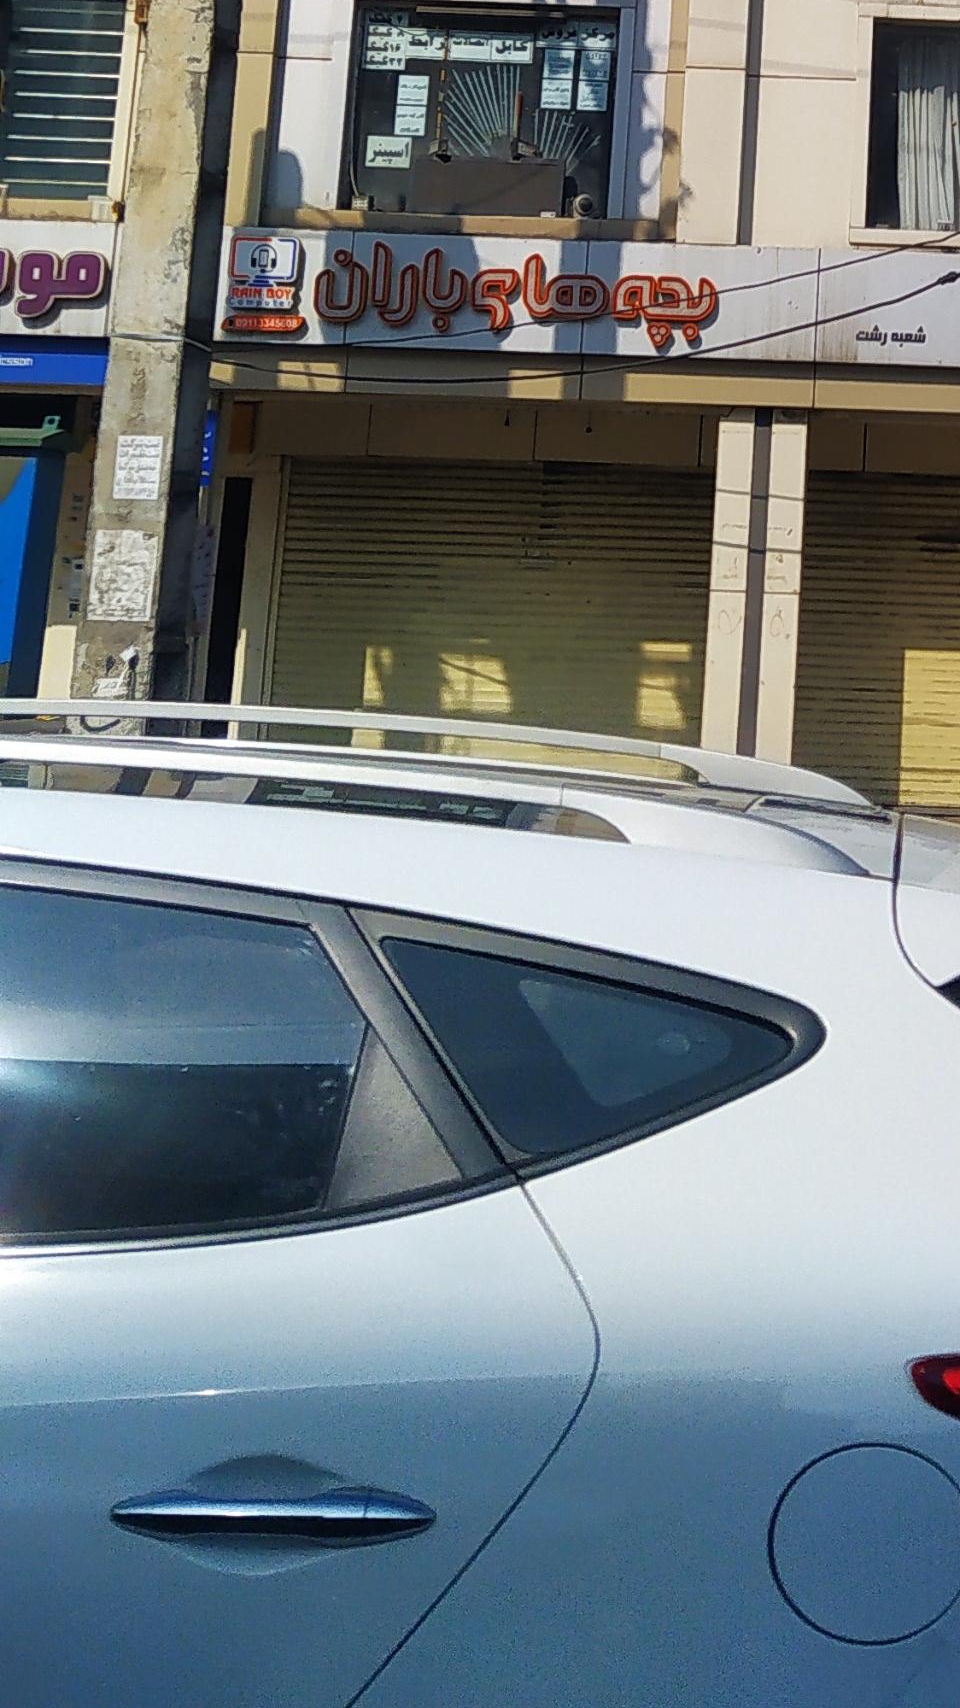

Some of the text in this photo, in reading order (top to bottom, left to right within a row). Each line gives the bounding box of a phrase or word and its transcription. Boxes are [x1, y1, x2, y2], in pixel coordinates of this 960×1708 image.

[266, 287, 292, 300] BOY
[313, 239, 717, 348] بچه های باران
[855, 323, 926, 348] شعبه رشت
